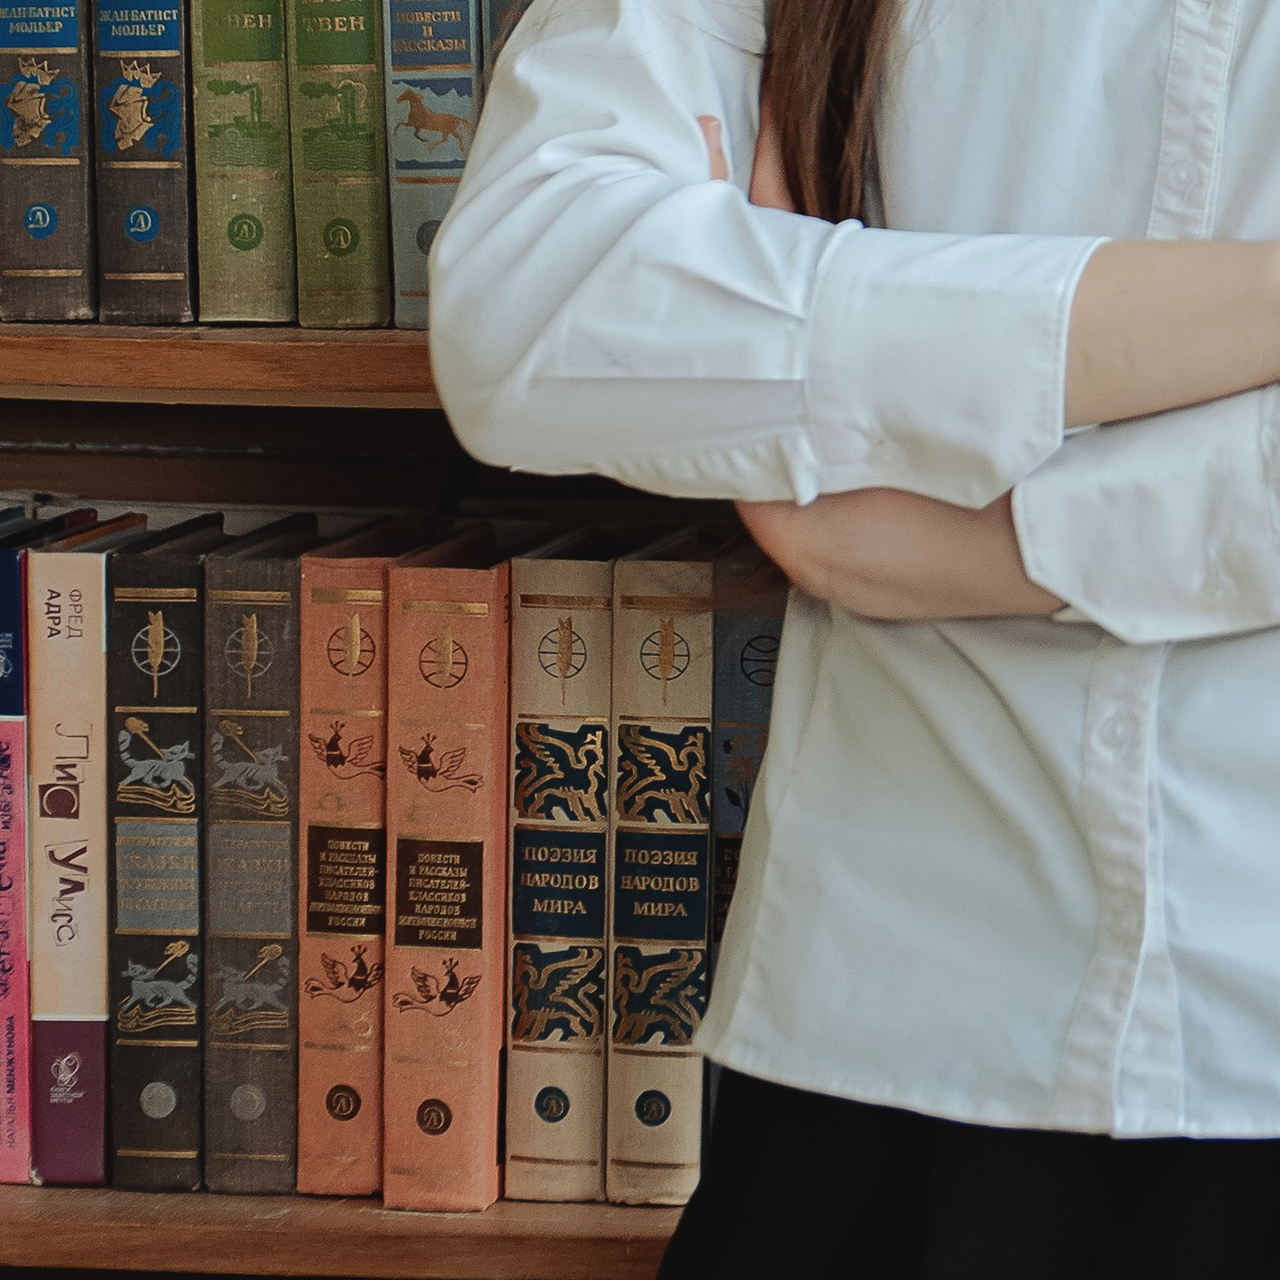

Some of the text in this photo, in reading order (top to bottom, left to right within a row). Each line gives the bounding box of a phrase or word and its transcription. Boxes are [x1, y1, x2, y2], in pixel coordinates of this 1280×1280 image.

[111, 23, 166, 36] МОЛЬЕР
[303, 15, 366, 33] ТВЕН
[44, 588, 62, 638] АДРА
[66, 589, 84, 639] ФРЕД
[523, 846, 598, 863] ПОЭЗИЯ
[624, 848, 699, 866] ПОЭЗИЯ
[520, 873, 599, 890] НАРОДОВ
[621, 875, 700, 892] НАРОДОВ
[532, 898, 587, 915] МИРА
[632, 901, 688, 917] МИРА
